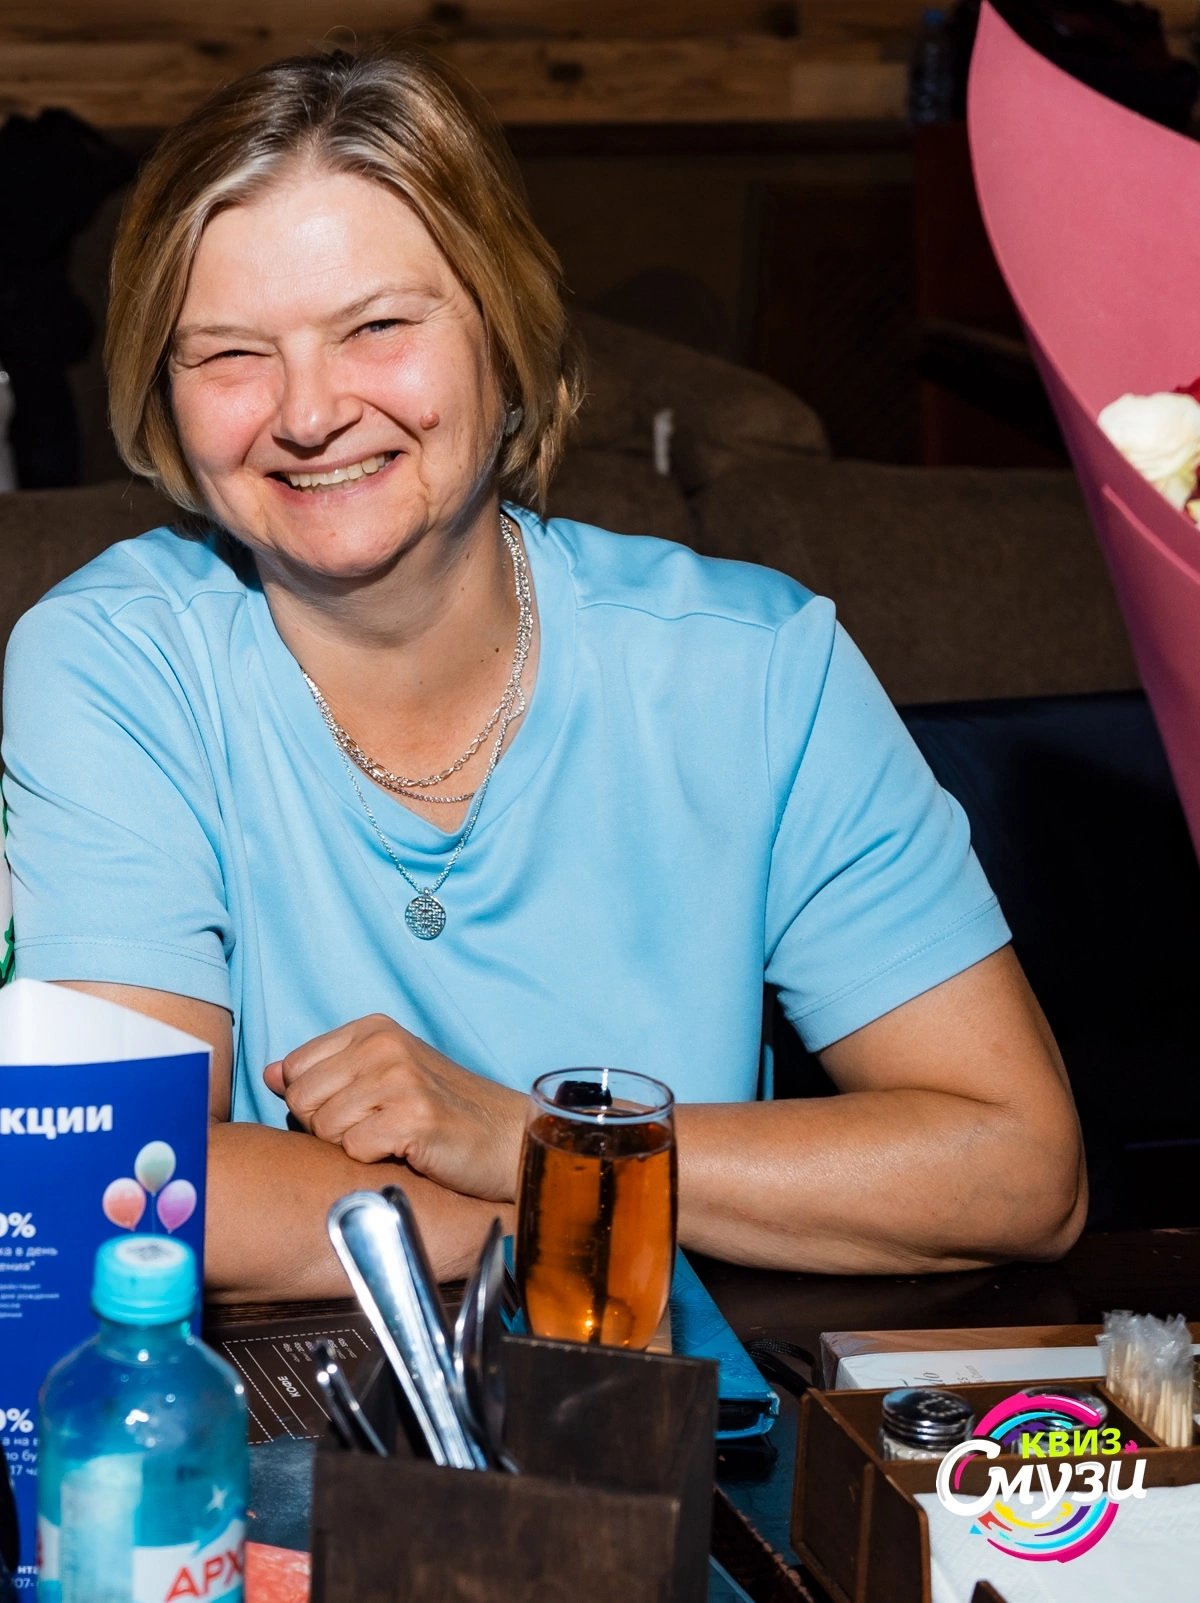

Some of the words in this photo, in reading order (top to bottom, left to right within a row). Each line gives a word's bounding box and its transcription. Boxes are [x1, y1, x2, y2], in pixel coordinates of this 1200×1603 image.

[15, 1246, 24, 1257] в
[25, 1246, 59, 1258] день
[277, 1375, 302, 1398] КОФЕ
[13, 1437, 30, 1447] на
[9, 1464, 23, 1475] 17
